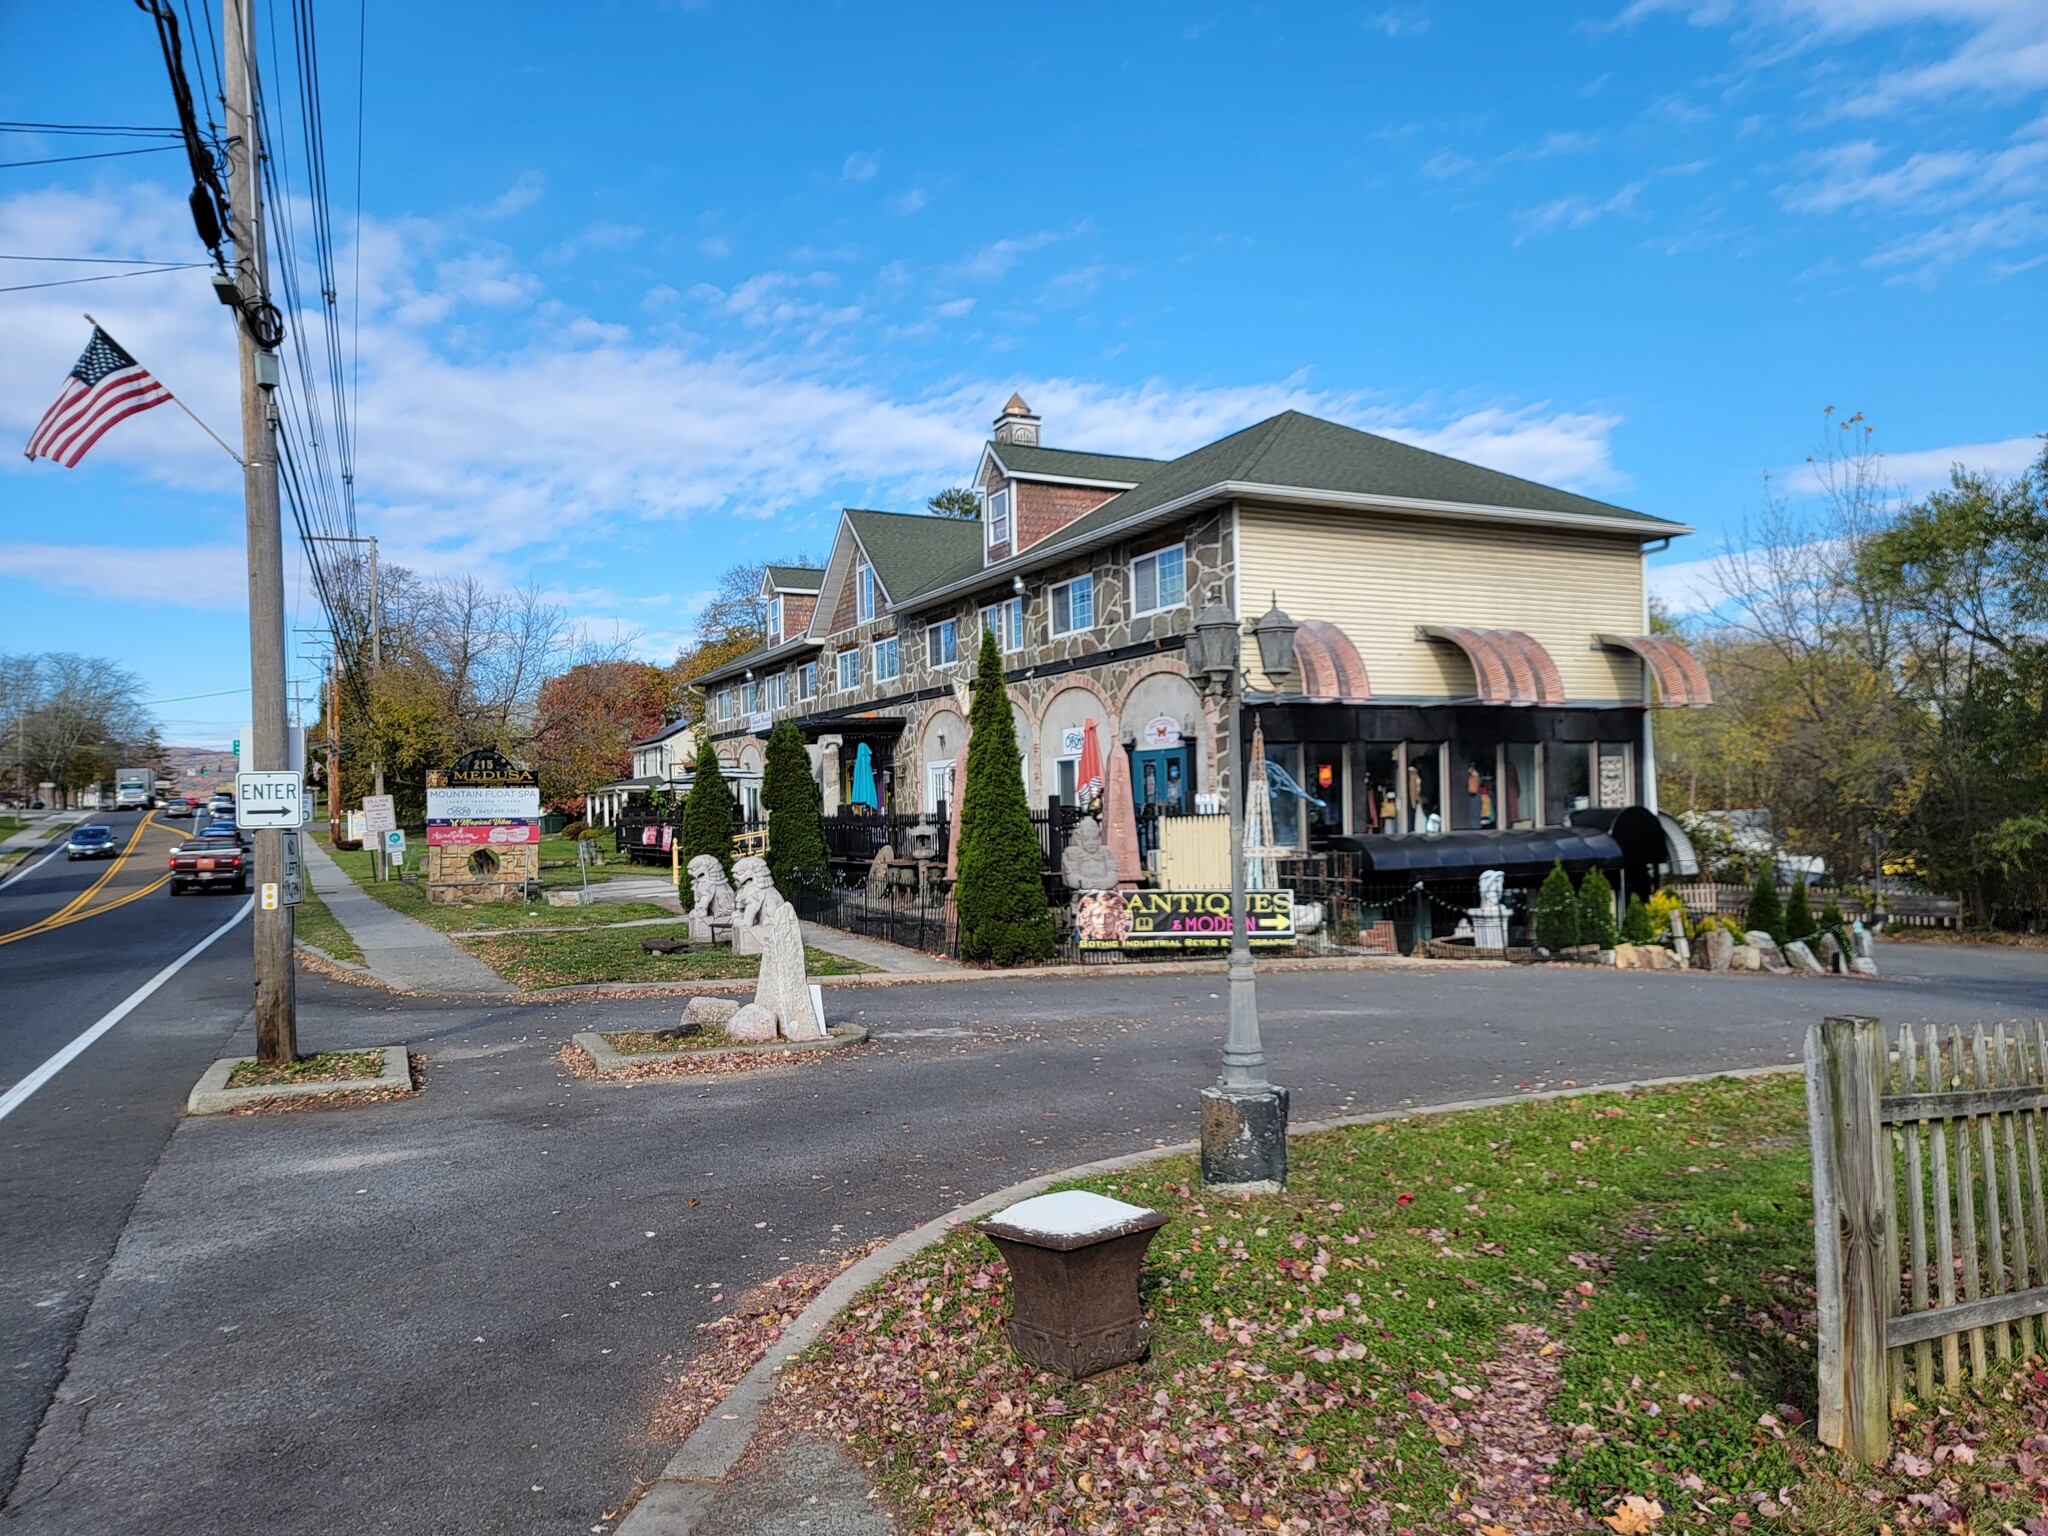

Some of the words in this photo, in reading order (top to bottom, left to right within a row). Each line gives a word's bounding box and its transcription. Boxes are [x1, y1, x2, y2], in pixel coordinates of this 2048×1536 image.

[473, 759, 494, 769] 215
[453, 770, 534, 780] MEDUSA
[241, 783, 297, 800] ENTER
[430, 790, 482, 798] MOUNTAIN
[485, 790, 516, 798] FLOAT
[518, 790, 537, 798] SPA
[1171, 919, 1183, 931] &
[1185, 915, 1257, 932] MODEN
[1079, 939, 1119, 948] GOTHIC
[1122, 939, 1183, 948] INDUSTRIAL
[1184, 938, 1219, 947] RETRO
